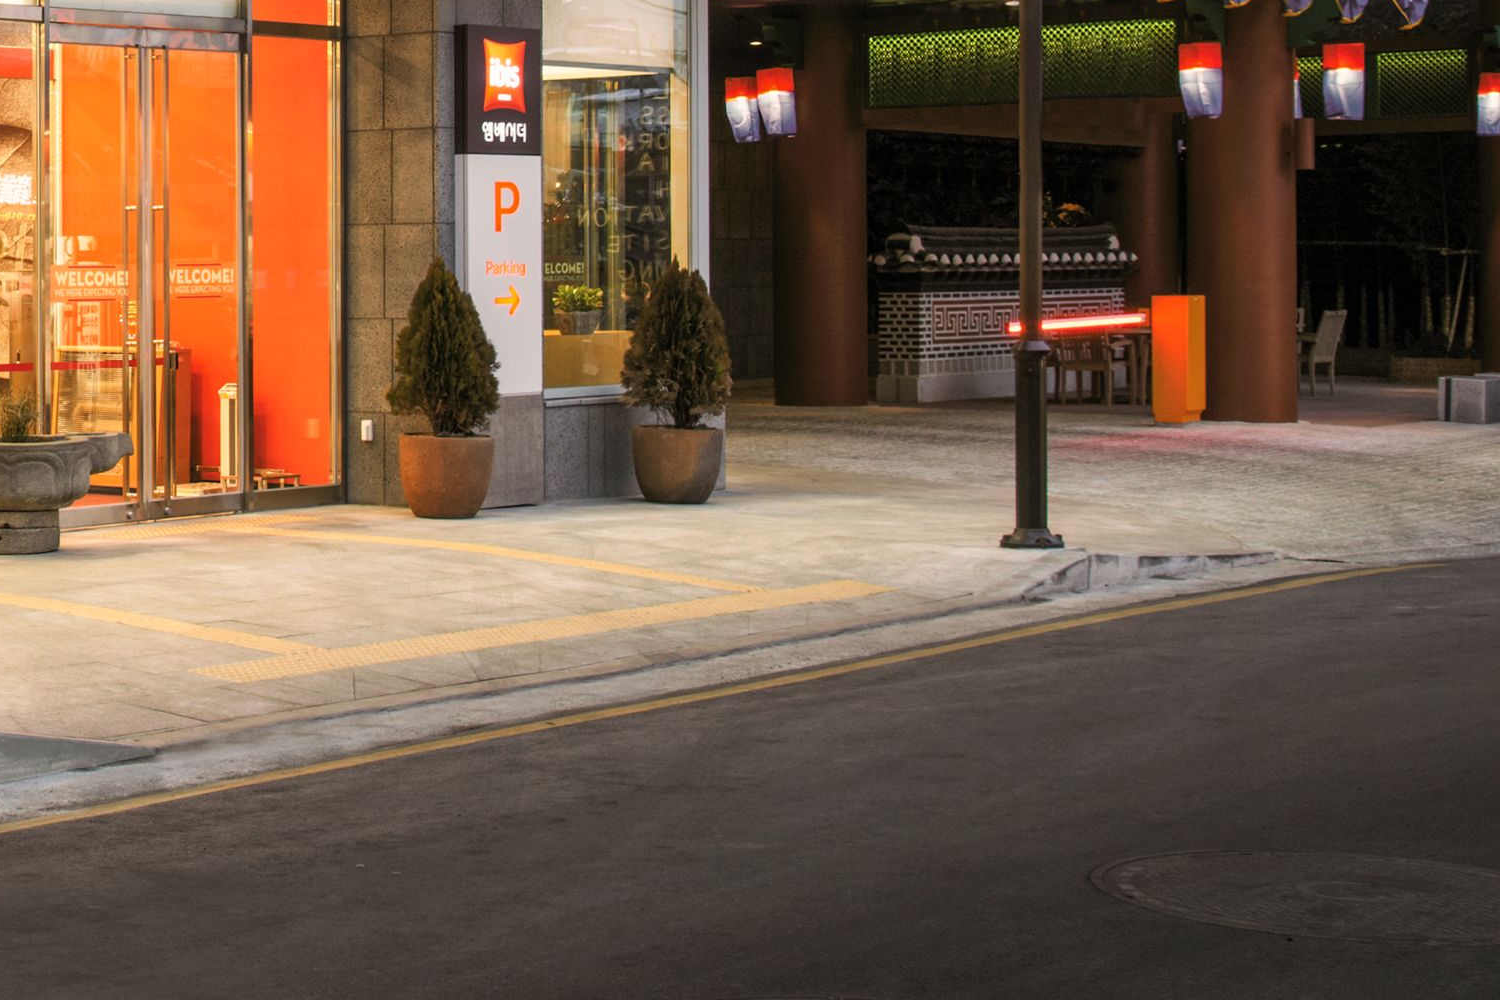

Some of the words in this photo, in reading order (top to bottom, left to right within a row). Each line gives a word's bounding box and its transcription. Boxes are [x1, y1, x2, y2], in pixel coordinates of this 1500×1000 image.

[489, 56, 520, 89] ibis
[494, 181, 520, 233] P
[485, 260, 526, 277] Parking
[543, 262, 585, 274] ELCOME!
[54, 271, 129, 287] WELCOME!
